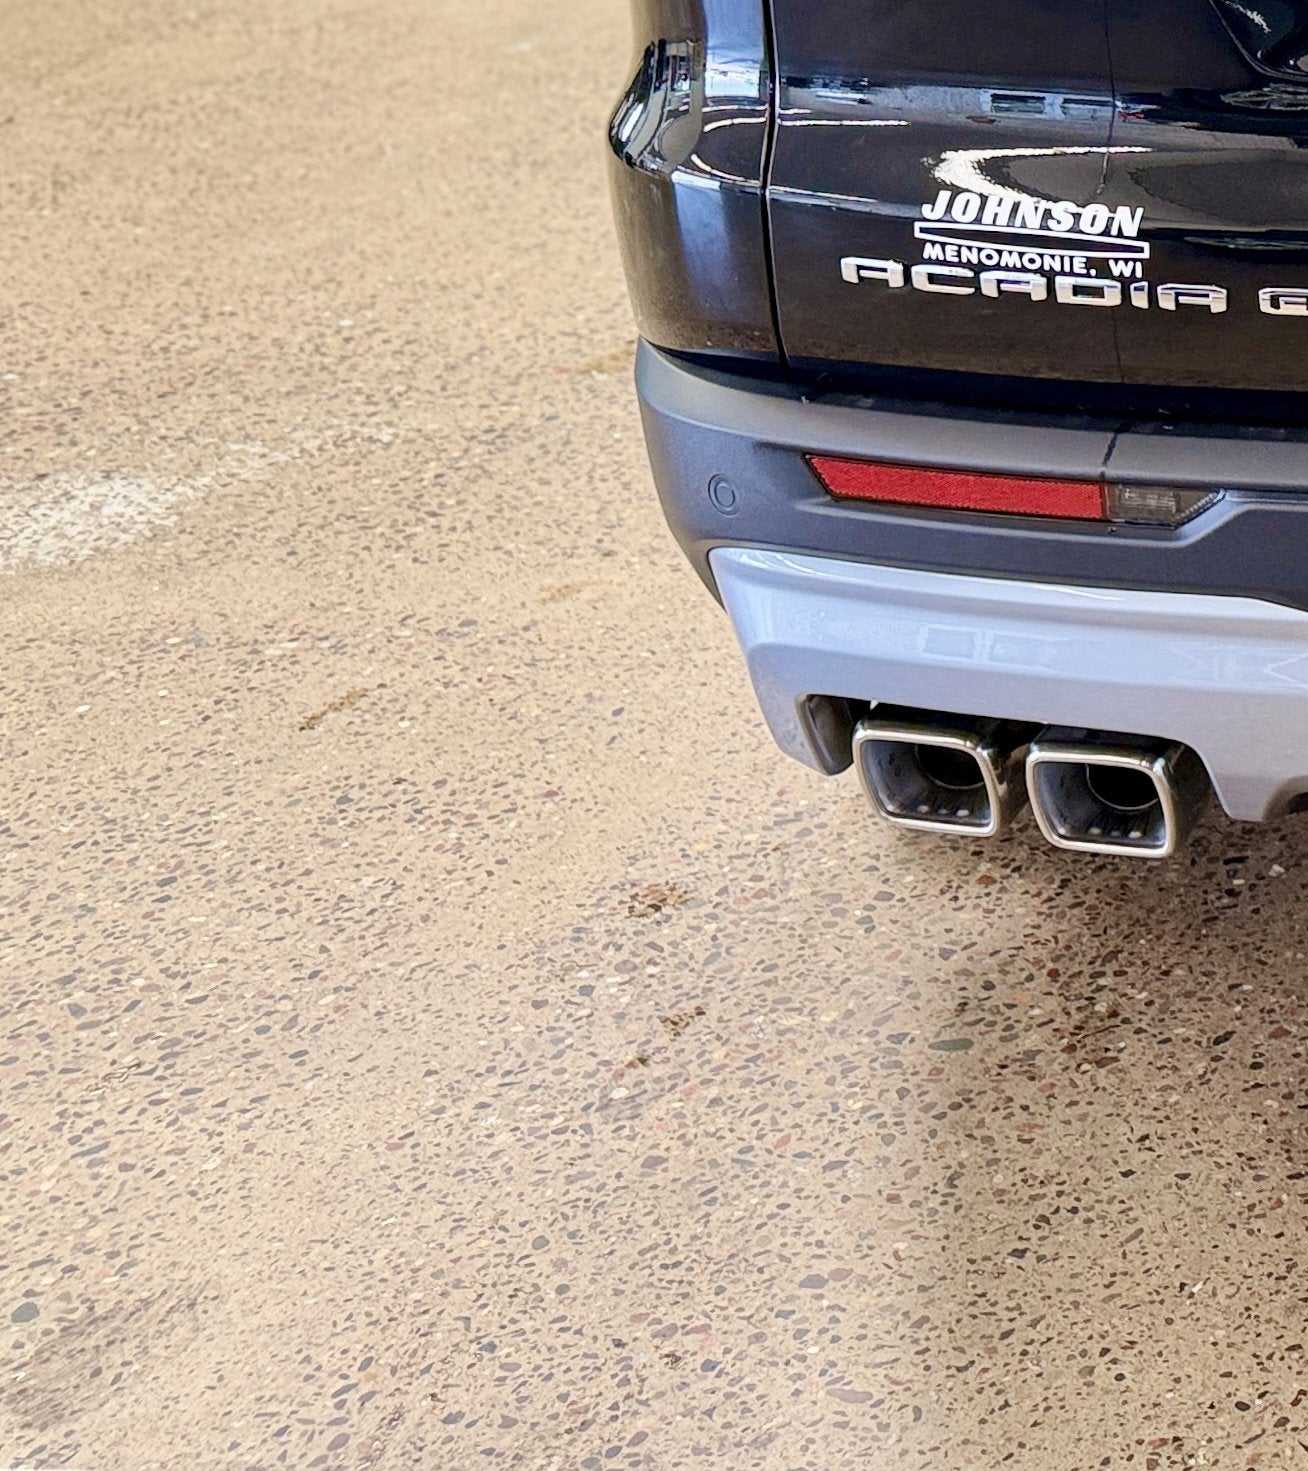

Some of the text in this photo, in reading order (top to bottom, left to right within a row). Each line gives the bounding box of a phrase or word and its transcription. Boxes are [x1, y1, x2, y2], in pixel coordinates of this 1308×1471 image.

[921, 190, 1144, 238] JOHNSON
[840, 255, 1228, 314] ACADIA
[1108, 258, 1143, 279] WI
